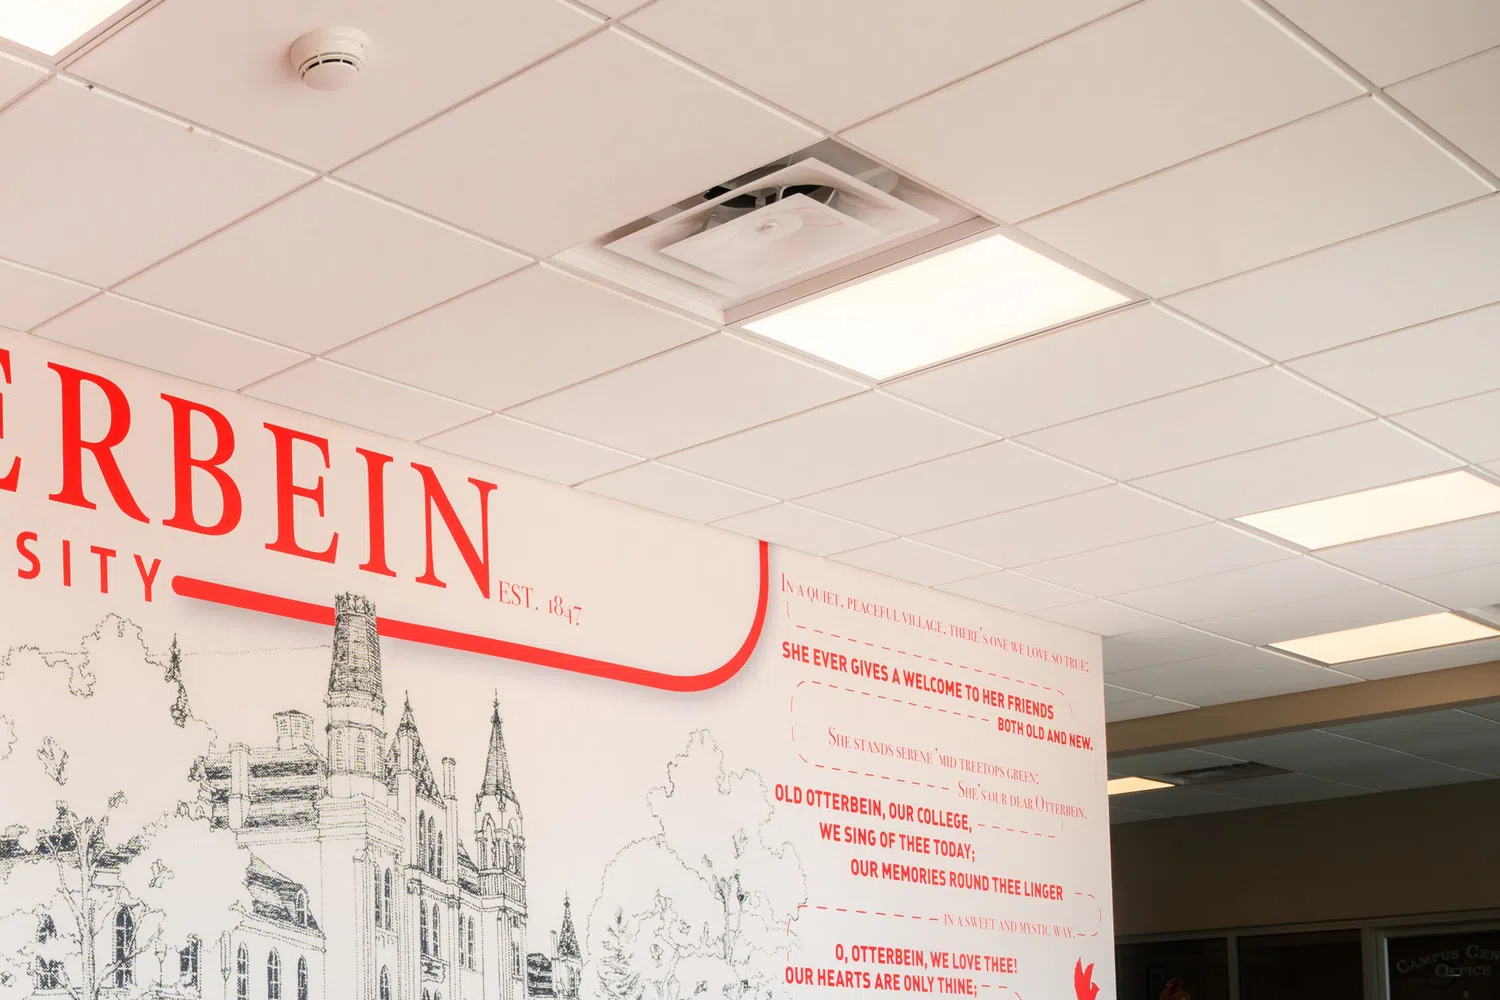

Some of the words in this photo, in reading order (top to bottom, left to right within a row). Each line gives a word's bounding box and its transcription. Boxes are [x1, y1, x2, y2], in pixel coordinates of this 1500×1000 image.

[498, 580, 538, 610] EST.
[548, 595, 582, 626] 1847
[797, 585, 804, 597] A
[847, 597, 899, 622] PEACEFUL
[990, 635, 1008, 651] ONE
[1010, 641, 1025, 656] WE
[1027, 646, 1050, 662] LOVE
[1051, 653, 1062, 665] SO
[782, 641, 809, 664] SHE
[813, 648, 848, 673] EVER
[851, 658, 888, 682] GIVES
[892, 668, 900, 685] A
[903, 670, 962, 699] WELCOME
[965, 685, 979, 703] TO
[982, 688, 1005, 709] HER
[1007, 694, 1054, 720] FRIENDS
[997, 717, 1024, 736] BOTH
[1026, 724, 1044, 740] OLD
[1047, 729, 1067, 745] AND
[1069, 733, 1093, 751] NEW.
[854, 738, 894, 757] STANDS
[896, 746, 933, 764] SERENE
[959, 758, 1005, 778] TREETOPS
[775, 784, 802, 804] OLD
[806, 789, 886, 820] OTTERBEIN,
[889, 802, 914, 822] OUR
[917, 807, 972, 834] COLLEGE,
[988, 791, 1007, 806] OUR
[1009, 795, 1033, 810] DEAR
[819, 822, 841, 842] WE
[844, 826, 877, 847] SING
[879, 831, 896, 849] OF
[899, 833, 930, 854] THEE
[933, 838, 975, 863] TODAY;
[851, 858, 878, 878] OUR
[882, 862, 946, 886] MEMORIES
[949, 871, 989, 892] ROUND
[992, 876, 1021, 895] THEE
[1024, 881, 1063, 901] LINGER
[944, 913, 954, 926] IN
[956, 915, 963, 927] A
[965, 916, 996, 931] SWEET
[998, 919, 1017, 933] AND
[1019, 921, 1051, 936] MYSTIC
[1053, 926, 1076, 939] WAY.
[835, 943, 848, 964] O,
[851, 944, 928, 970] OTTERBEIN,
[930, 951, 949, 969] WE
[952, 953, 981, 971] LOVE
[984, 956, 1018, 974] THEE!
[1396, 949, 1460, 973] CAMPUS
[1434, 963, 1492, 978] OFFICE
[785, 966, 814, 985] OUR
[817, 969, 870, 989] HEARTS
[874, 973, 900, 991] ARE
[903, 975, 934, 993] ONLY
[937, 977, 978, 998] THINE;
